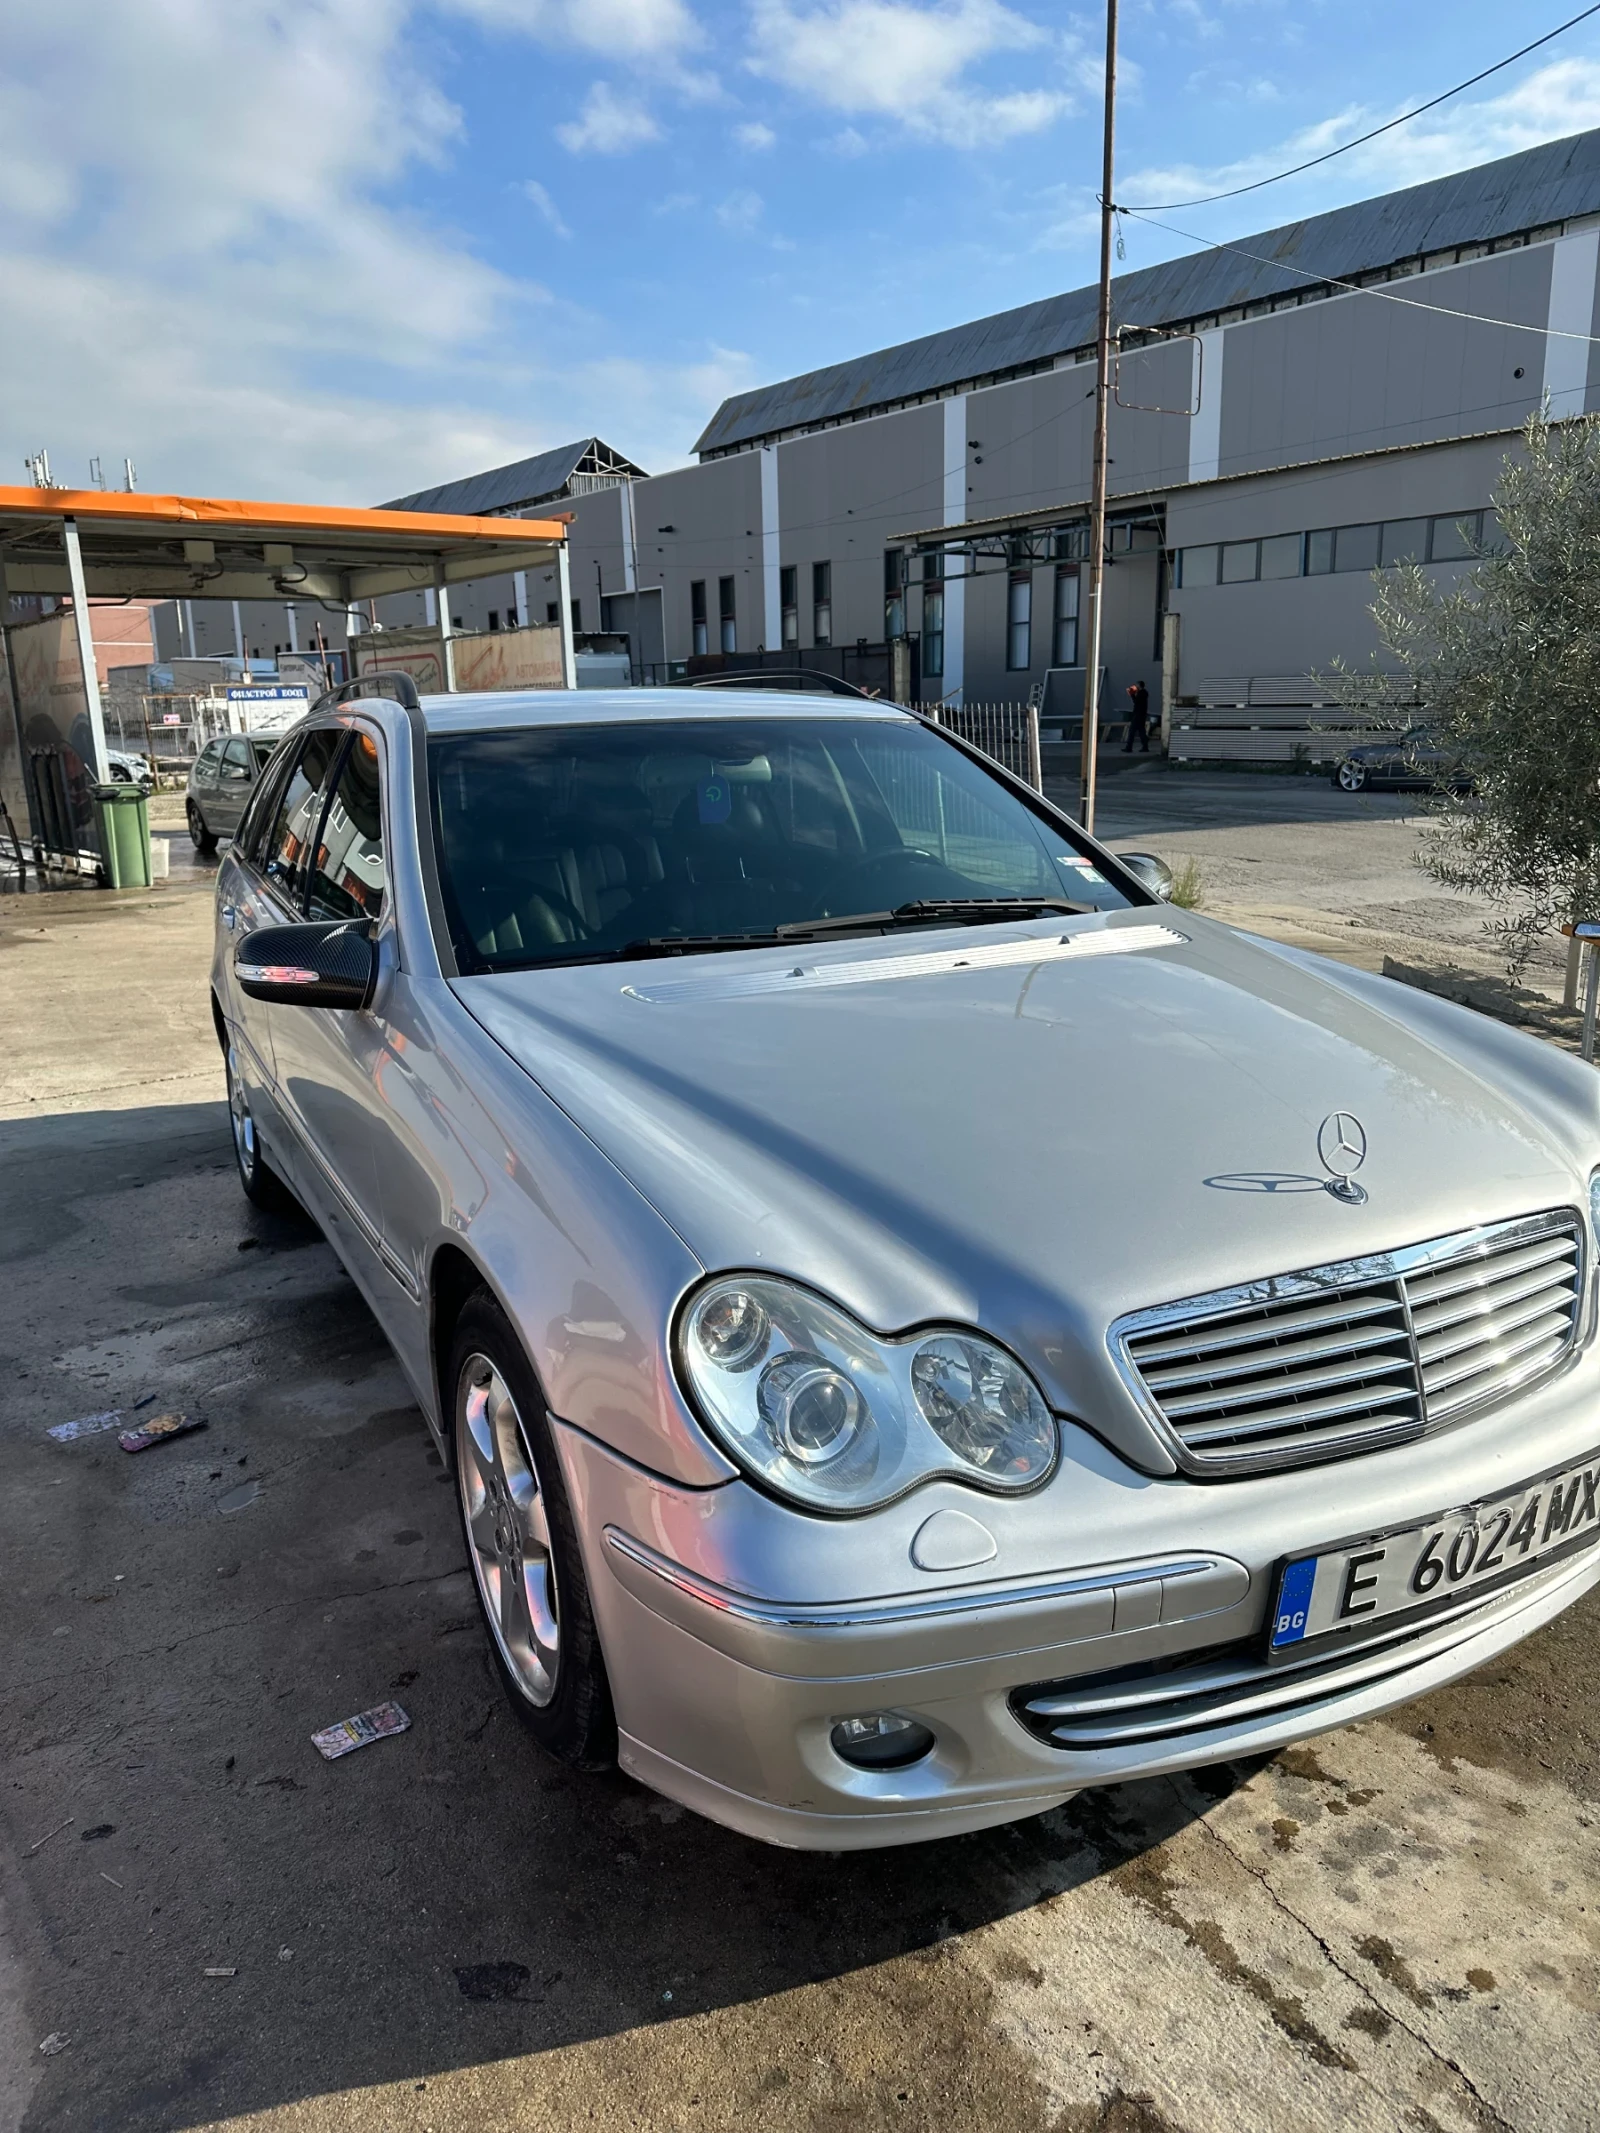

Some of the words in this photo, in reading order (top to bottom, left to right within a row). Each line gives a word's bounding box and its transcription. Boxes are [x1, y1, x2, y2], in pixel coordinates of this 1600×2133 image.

[281, 688, 305, 698] ЕООД
[1340, 1549, 1386, 1619] E
[1413, 1493, 1541, 1594] 6024
[1277, 1611, 1304, 1633] BG
